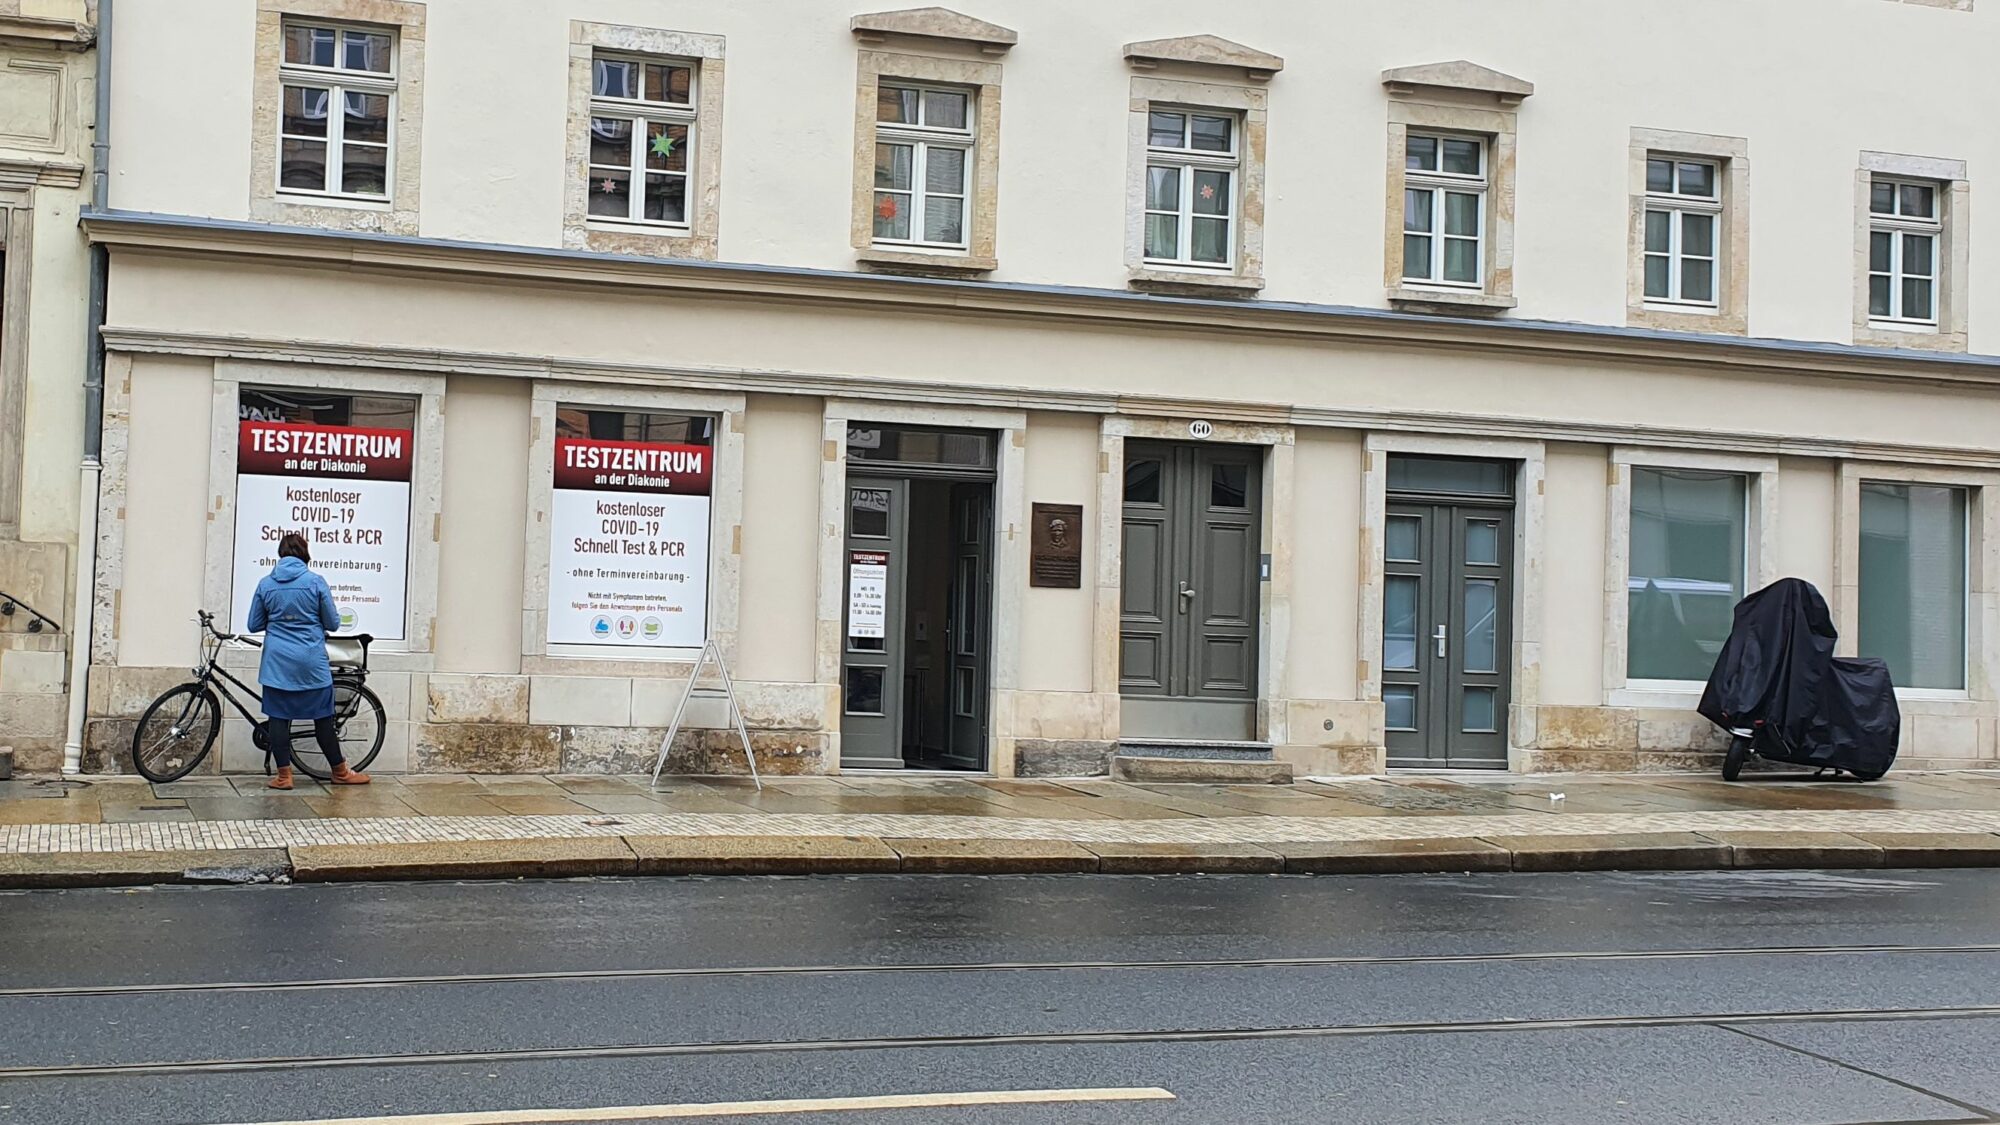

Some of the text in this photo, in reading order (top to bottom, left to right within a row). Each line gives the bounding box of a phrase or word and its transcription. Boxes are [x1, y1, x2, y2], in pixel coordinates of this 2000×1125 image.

[1193, 424, 1210, 434] 60
[251, 428, 401, 458] TESTZENTRUM
[284, 458, 366, 473] an der Diakonie
[564, 445, 702, 474] TESTZENTRUM
[594, 473, 670, 487] an der Diakonie
[286, 486, 362, 504] kostenloser
[292, 506, 355, 524] COVID-19
[596, 500, 666, 517] kostenloser
[602, 519, 659, 536] COVID-19
[314, 528, 339, 543] Test
[343, 528, 352, 544] &
[357, 529, 382, 545] PCR
[574, 538, 685, 557] Schnell Test & PCR
[260, 557, 276, 566] ohn
[309, 559, 382, 572] invereinbarung
[573, 568, 593, 578] ohne
[596, 568, 684, 583] Terminvereinbarung
[613, 593, 643, 601] Symptomen
[572, 602, 588, 610] folgen
